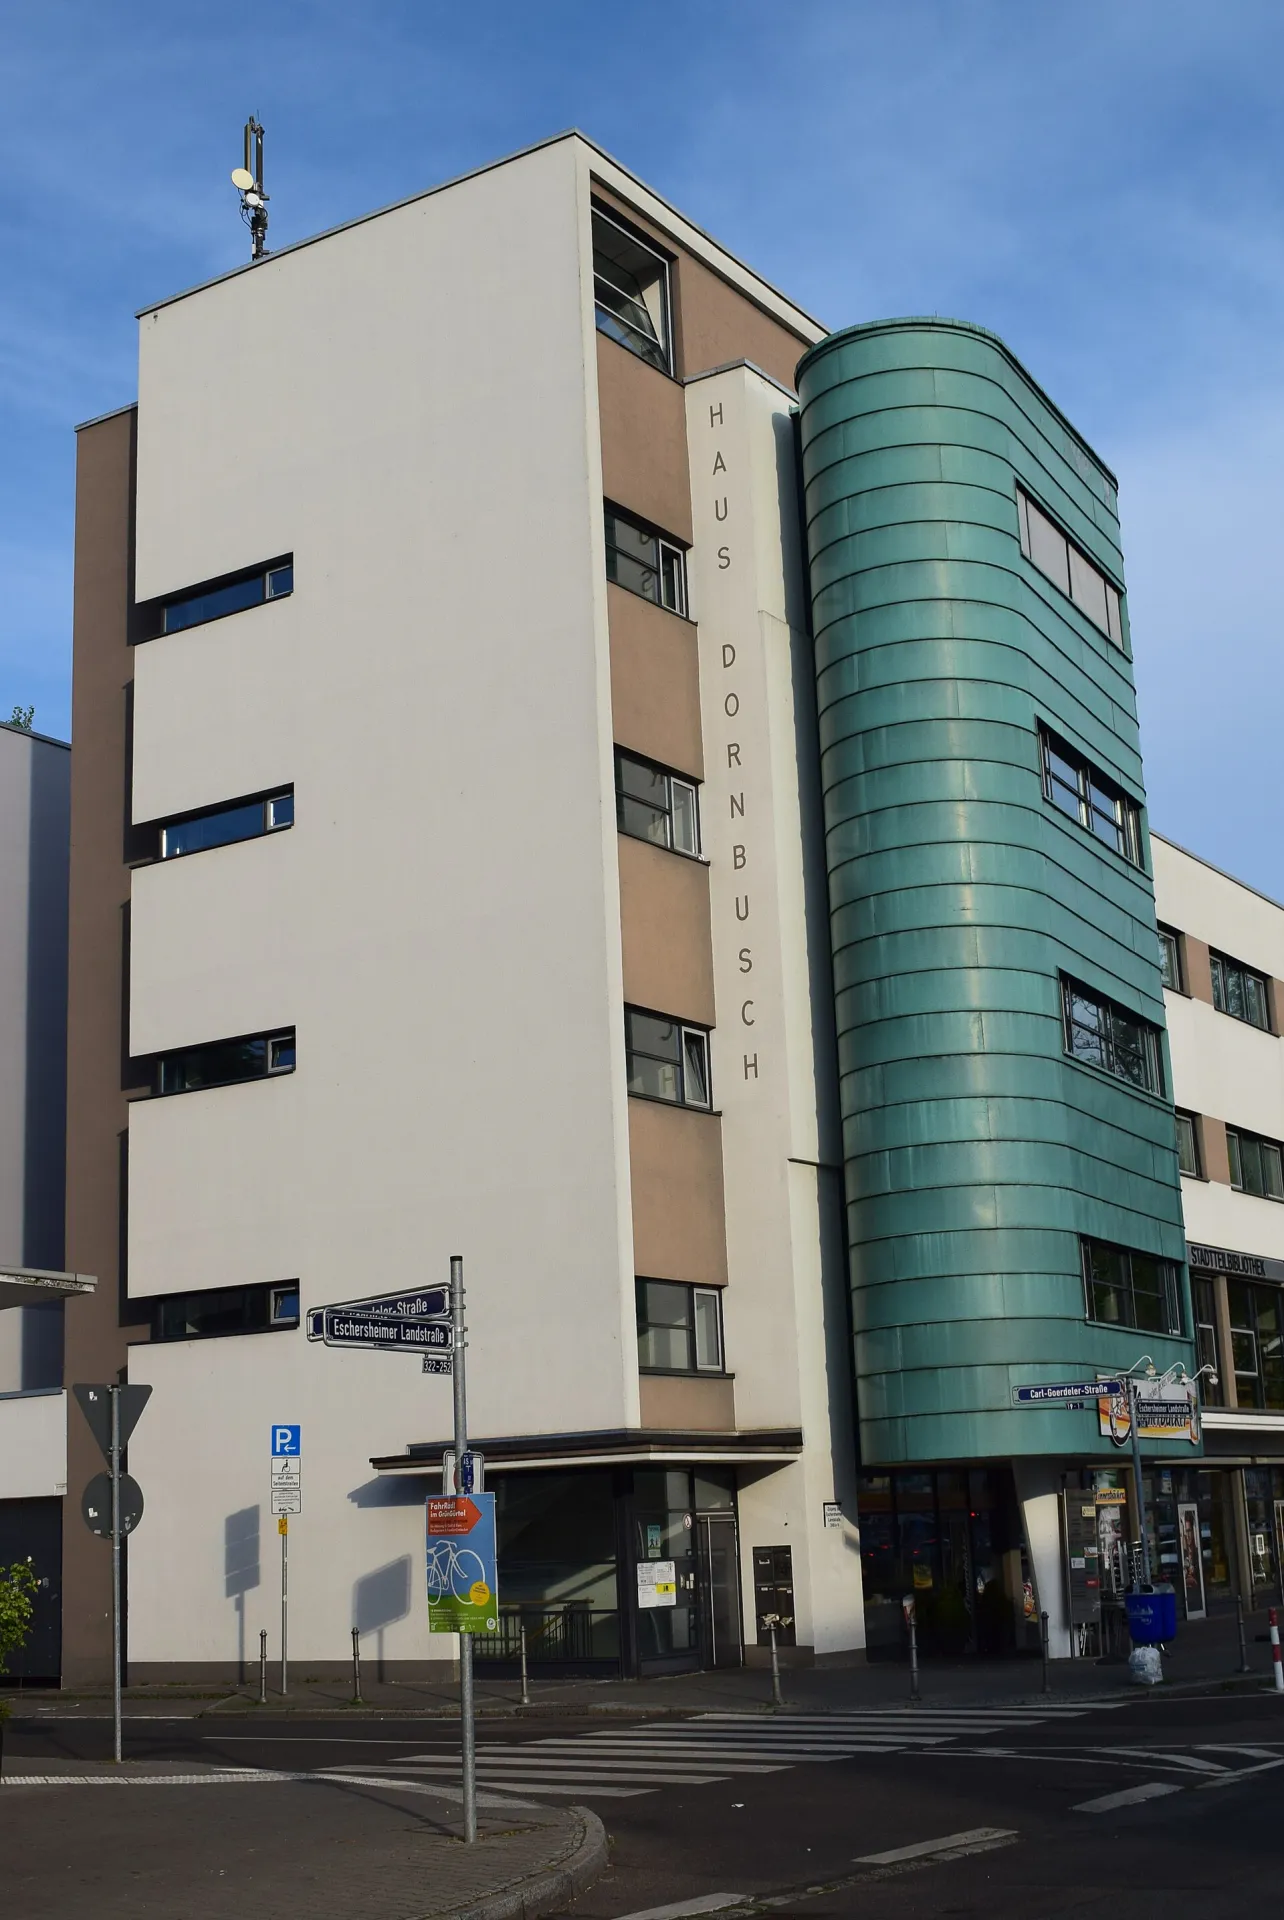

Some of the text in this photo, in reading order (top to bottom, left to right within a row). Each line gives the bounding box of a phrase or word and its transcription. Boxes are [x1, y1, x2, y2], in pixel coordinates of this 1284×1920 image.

[709, 402, 731, 569] HAUS
[722, 643, 758, 1080] DORNBUSCH
[1190, 1245, 1266, 1276] STADTTEILBIBLIOTHEK
[333, 1318, 444, 1343] Eschersheimer Landstraße
[424, 1360, 451, 1373] 322-252
[1030, 1384, 1108, 1398] Carl-Goerdeler-Straße
[1138, 1403, 1189, 1413] Eschersheimer Landstraße
